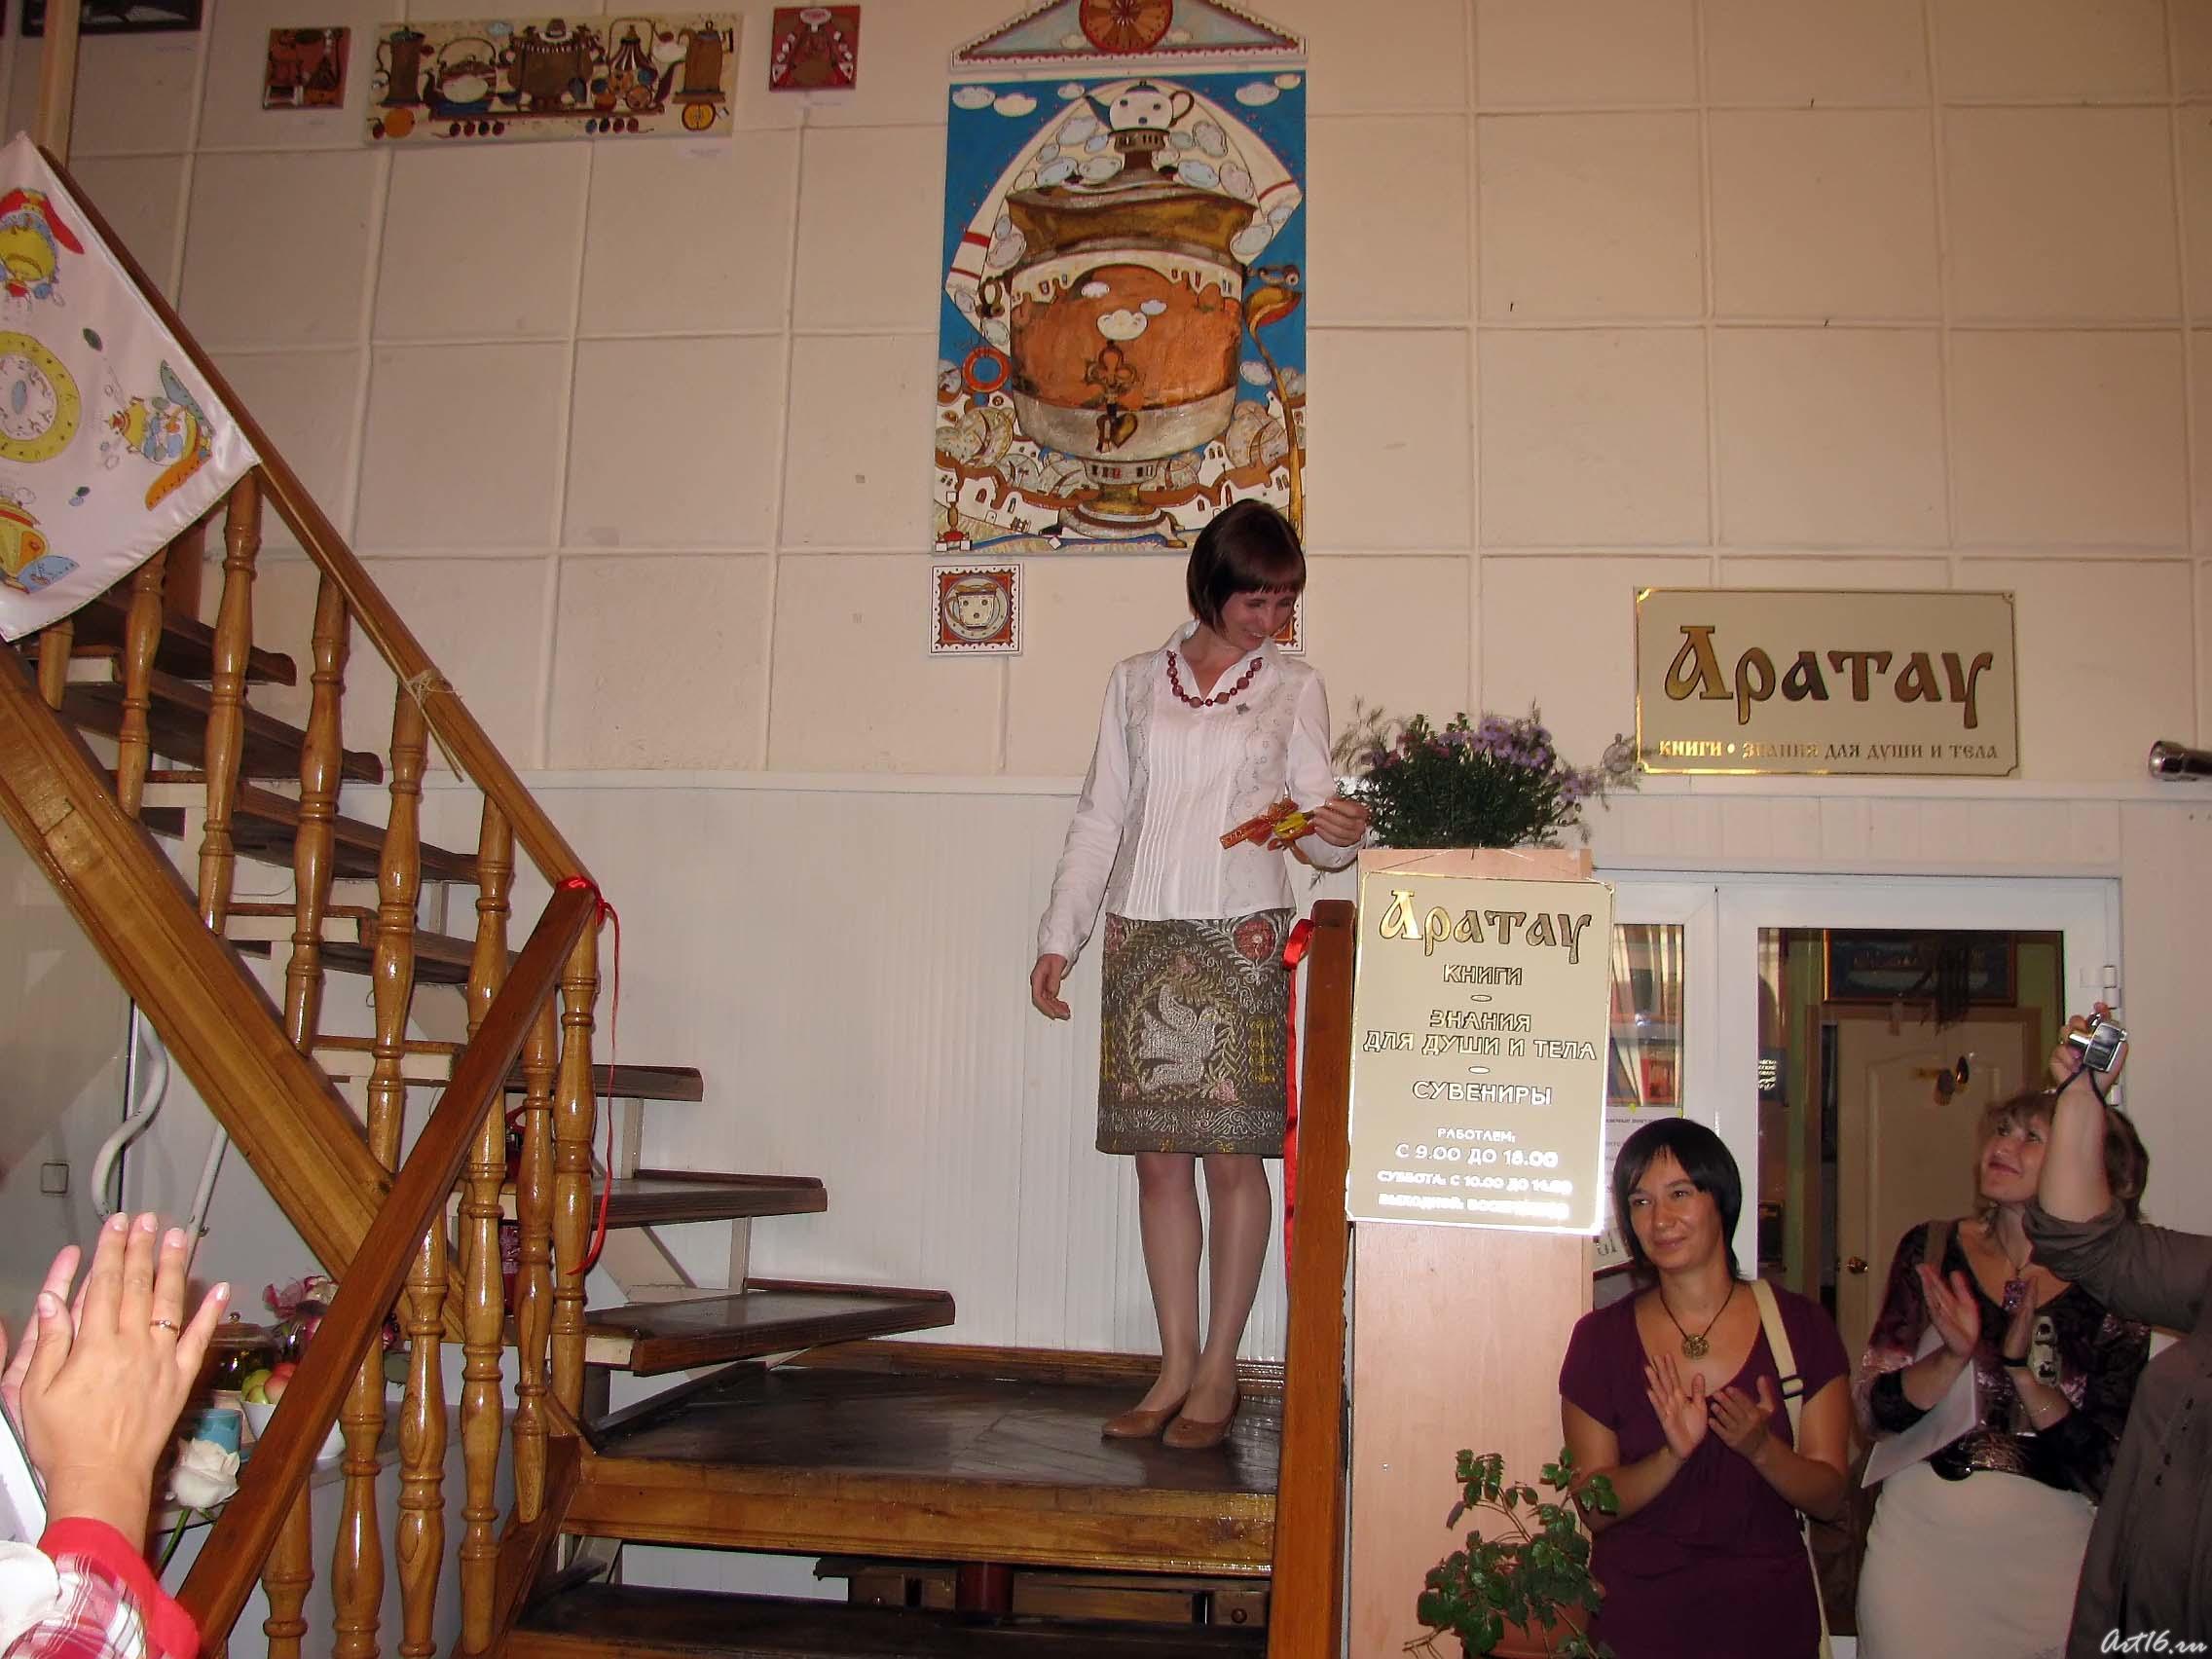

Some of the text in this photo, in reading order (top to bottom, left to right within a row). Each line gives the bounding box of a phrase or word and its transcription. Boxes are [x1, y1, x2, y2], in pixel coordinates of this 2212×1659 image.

[1664, 625, 1993, 729] Аратау
[1379, 889, 1592, 964] Аратау
[1443, 964, 1523, 986] КНИГИ
[1429, 1009, 1531, 1033] ЗНАНИЯ
[1362, 1030, 1598, 1061] ДЛЯ ДУШИ И ТЕЛА
[1412, 1080, 1553, 1106] СУВЕНИРЫ
[1395, 1143, 1410, 1159] С
[1415, 1144, 1461, 1161] 9.00
[1467, 1148, 1498, 1165] ДО
